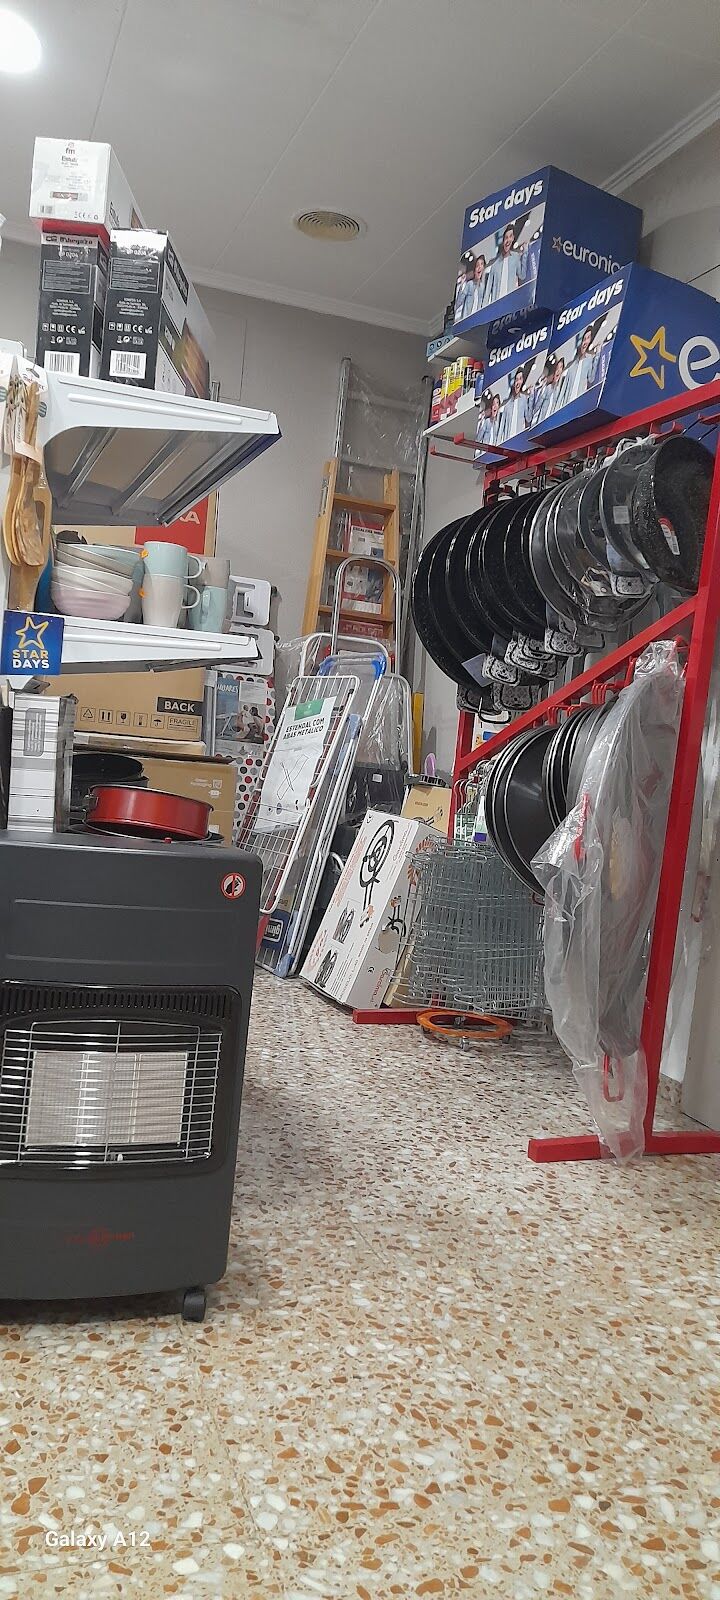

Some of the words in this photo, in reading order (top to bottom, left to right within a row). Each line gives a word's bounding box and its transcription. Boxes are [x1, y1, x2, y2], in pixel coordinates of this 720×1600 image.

[469, 203, 502, 228] Star
[504, 179, 544, 210] days
[563, 239, 624, 275] euronic
[557, 303, 585, 330] Star
[588, 278, 624, 311] days
[488, 343, 514, 367] Star
[516, 326, 548, 354] days
[12, 649, 49, 660] STAR
[12, 659, 50, 669] DAYS
[164, 700, 195, 713] BACK
[313, 718, 325, 727] COM
